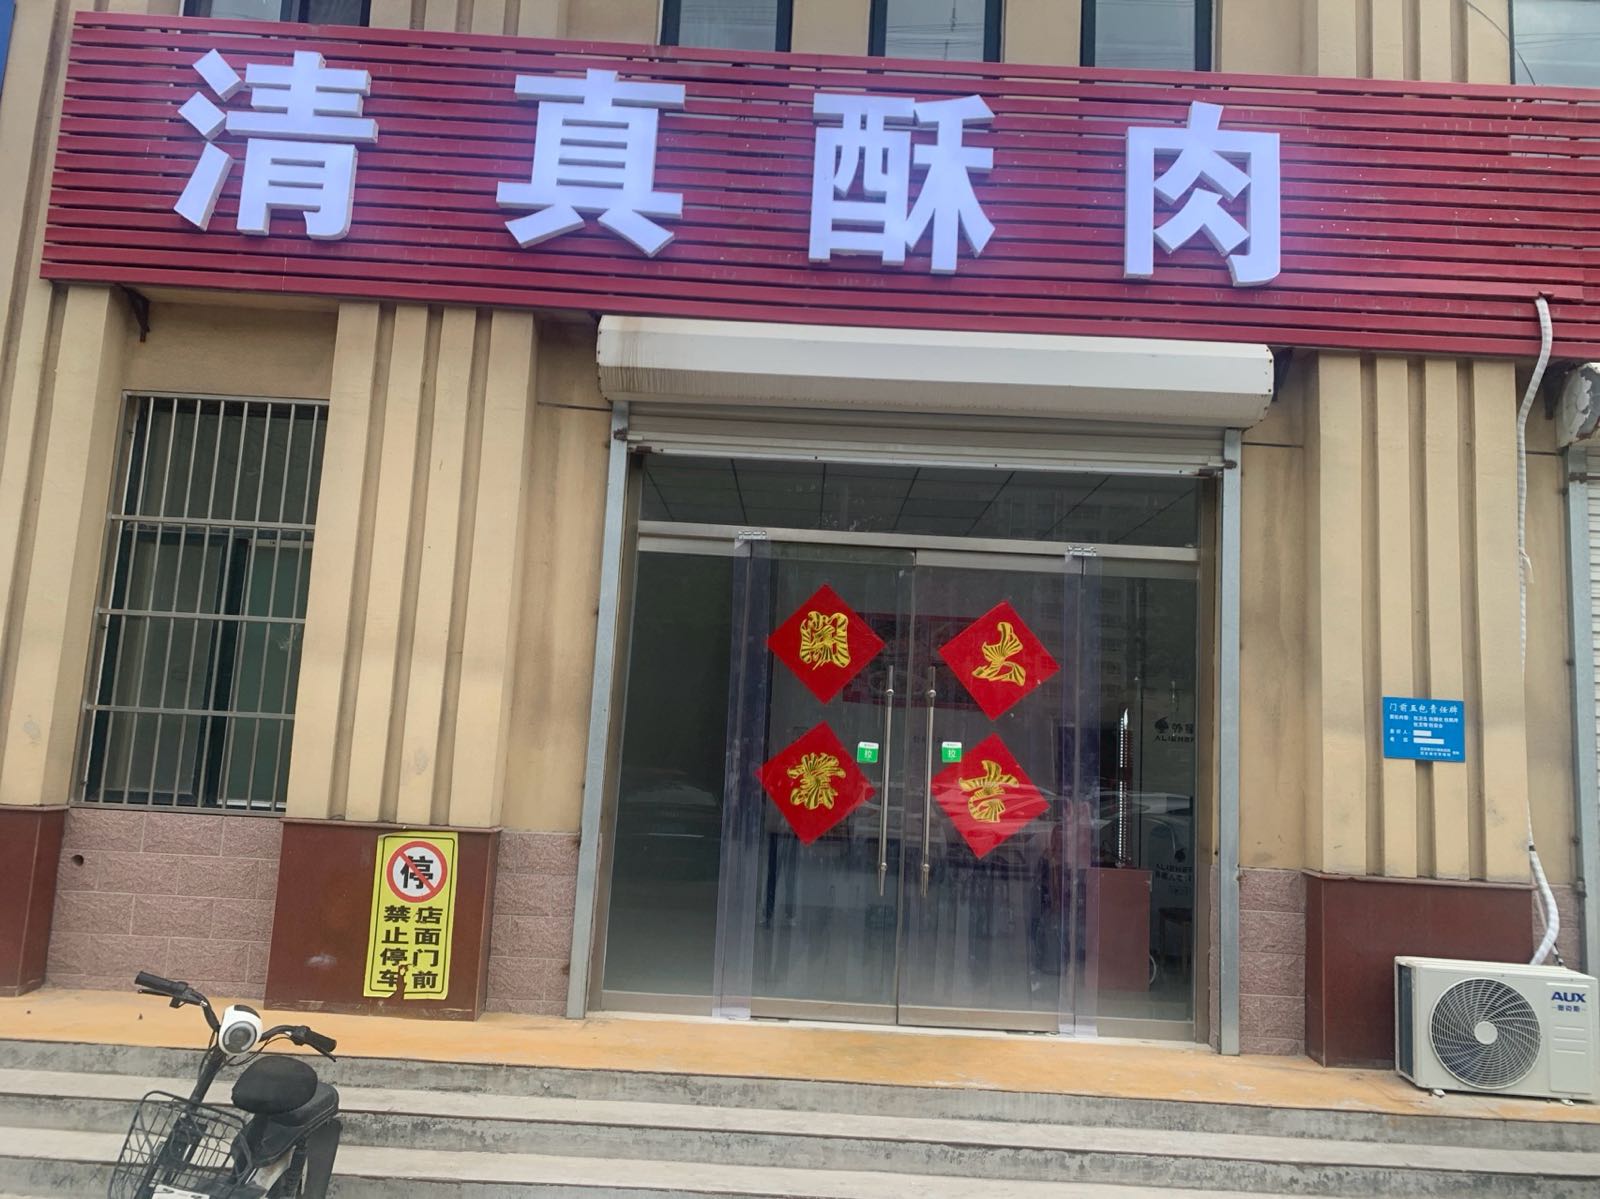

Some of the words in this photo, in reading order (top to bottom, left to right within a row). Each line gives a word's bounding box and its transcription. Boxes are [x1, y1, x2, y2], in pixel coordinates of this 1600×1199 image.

[173, 48, 1281, 288] 清真酥肉
[400, 855, 434, 890] 停
[377, 905, 411, 988] 禁止停车
[411, 906, 444, 989] 店面门前
[1551, 991, 1586, 1003] AUX
